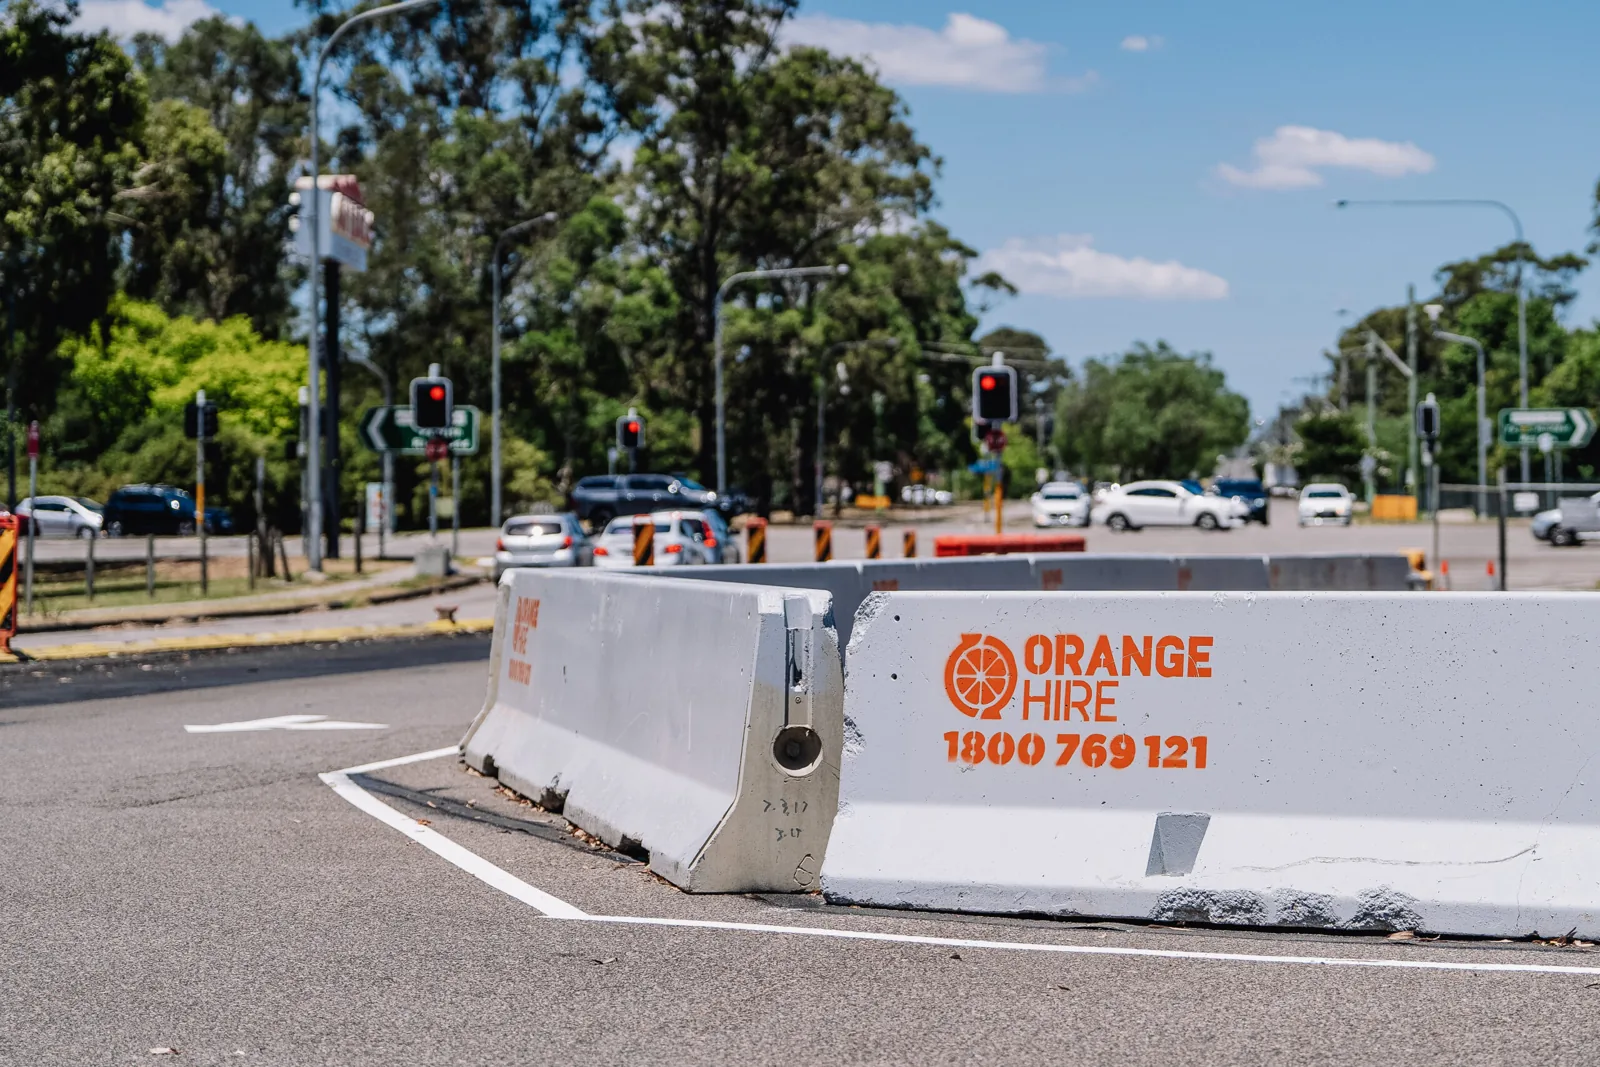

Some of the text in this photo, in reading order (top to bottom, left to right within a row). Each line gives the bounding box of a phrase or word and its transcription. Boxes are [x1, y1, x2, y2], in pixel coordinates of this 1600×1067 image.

[1024, 633, 1214, 678] ORANGE
[1022, 679, 1119, 722] HIRE
[943, 731, 1208, 770] 1800 769 121
